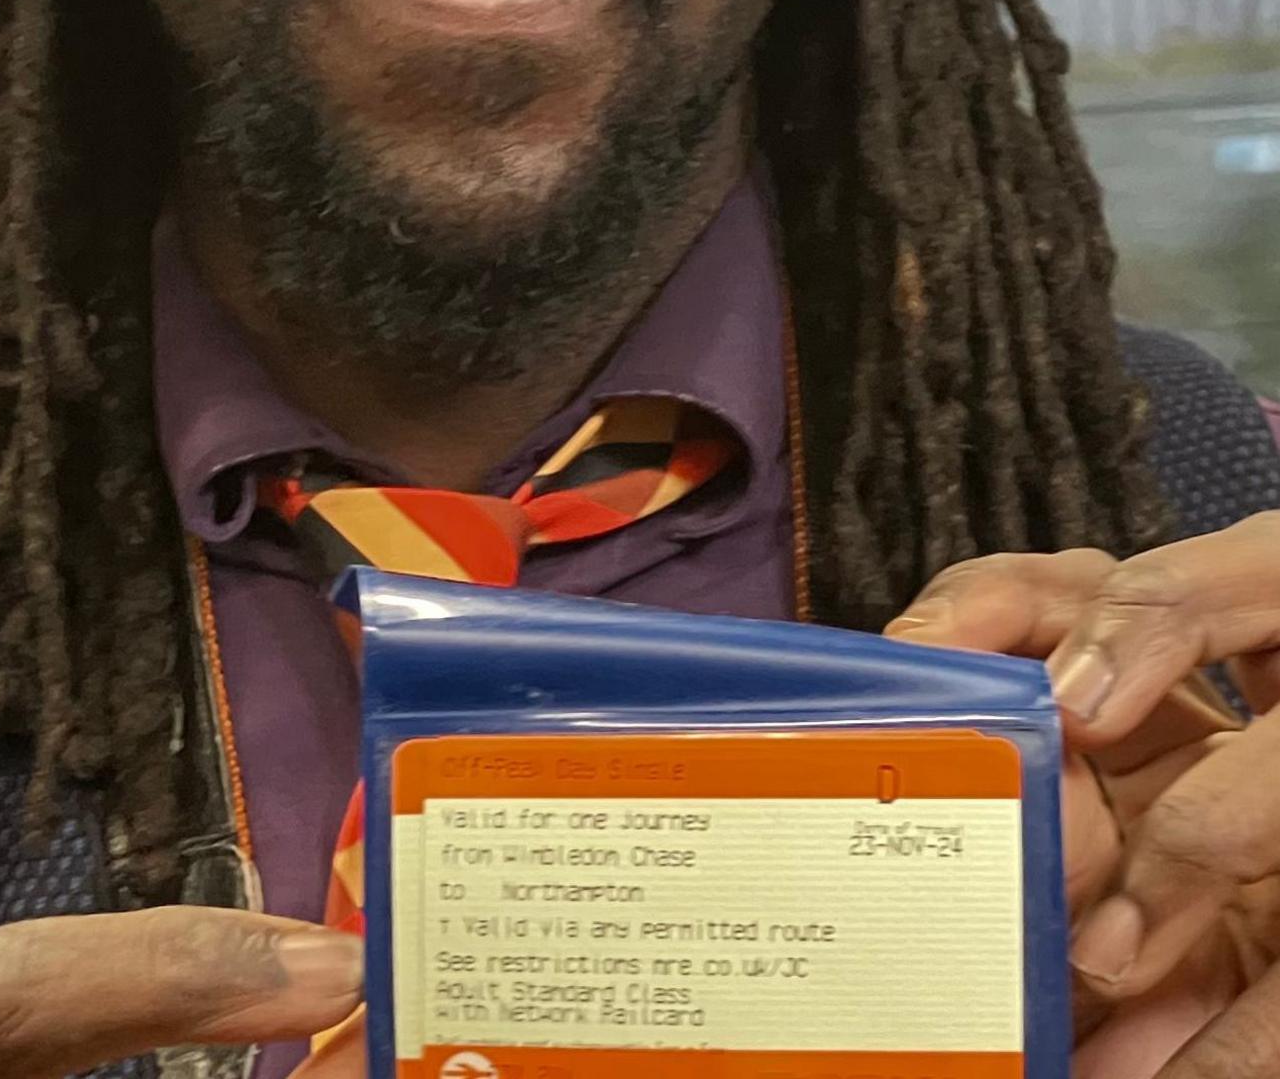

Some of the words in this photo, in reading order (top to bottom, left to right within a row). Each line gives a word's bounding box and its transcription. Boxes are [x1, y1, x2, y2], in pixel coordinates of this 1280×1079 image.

[442, 809, 507, 830] Valid
[522, 808, 555, 830] for
[570, 811, 608, 830] one
[442, 844, 493, 866] from
[504, 845, 620, 867] Wimbledon
[632, 846, 697, 869] Chase
[849, 835, 964, 858] 23-NOV-24
[440, 882, 465, 901] to
[501, 884, 645, 903] Northampton
[463, 917, 528, 938] Valid
[539, 918, 579, 938] via
[590, 920, 630, 940] any
[642, 920, 759, 942] permitted
[768, 924, 837, 943] route
[436, 951, 476, 972] See
[486, 955, 641, 975] restrictions
[436, 980, 500, 1001] Adult
[512, 980, 616, 1003] Standard
[625, 982, 692, 1005] Class
[500, 1003, 587, 1023] Network
[602, 1005, 705, 1027] Railcard
